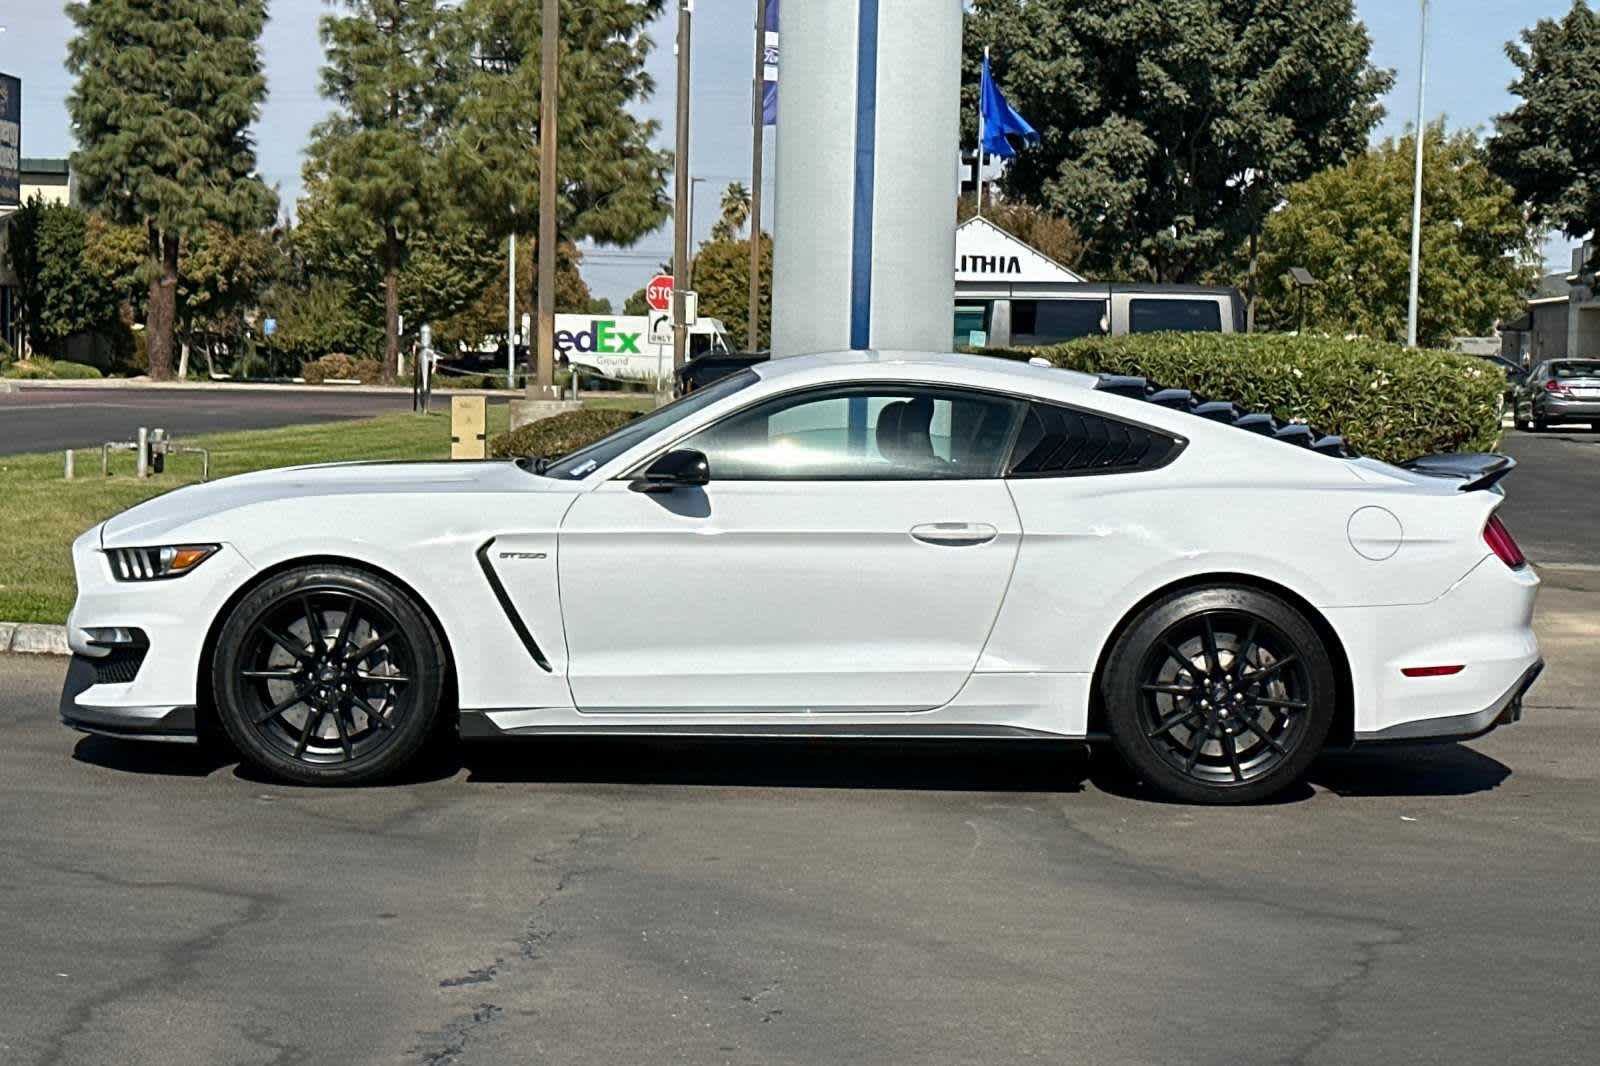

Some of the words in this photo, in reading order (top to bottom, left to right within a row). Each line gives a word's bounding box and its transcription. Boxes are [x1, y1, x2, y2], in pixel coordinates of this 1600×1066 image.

[956, 255, 1021, 274] ITHIA
[650, 286, 671, 300] STO
[554, 320, 642, 353] edEx
